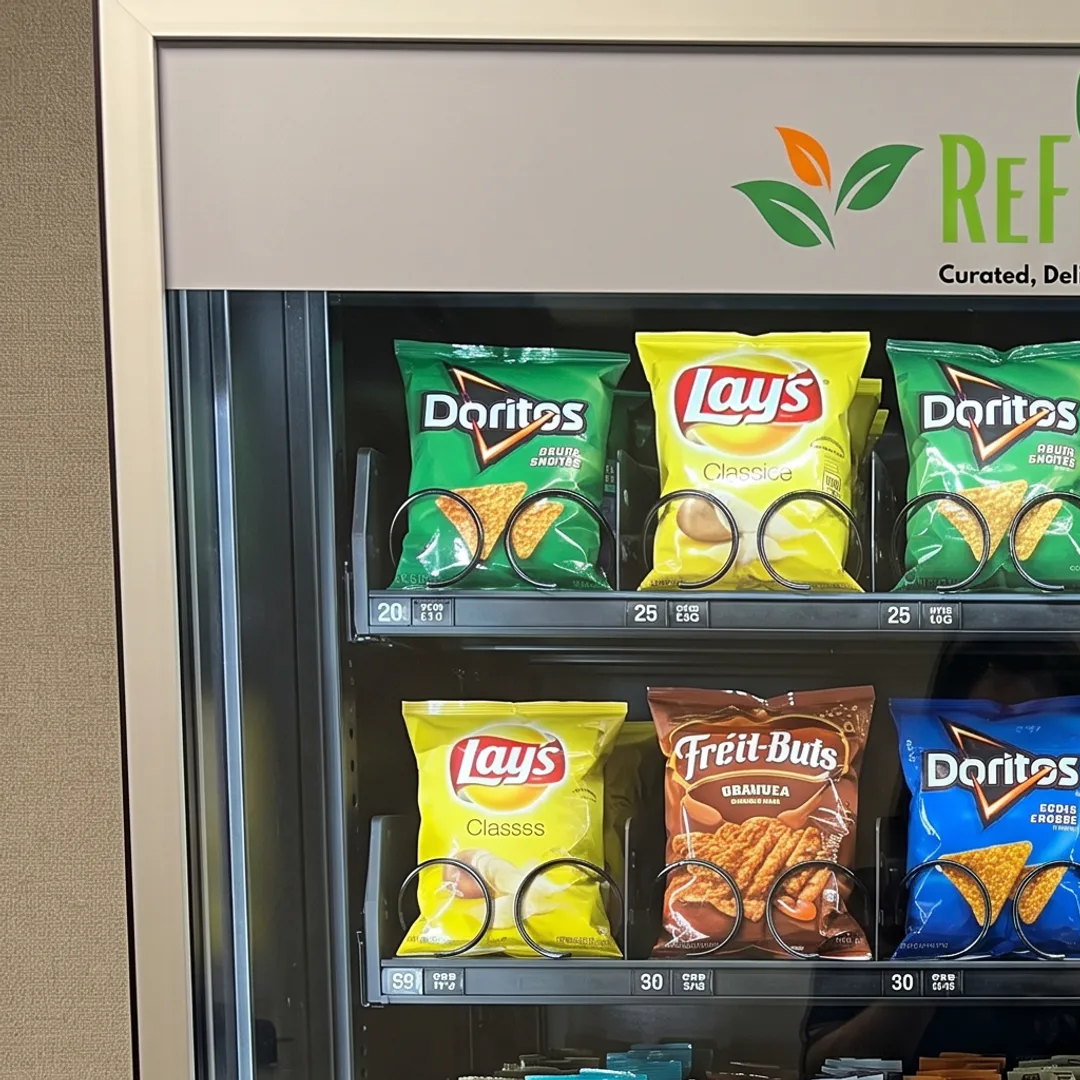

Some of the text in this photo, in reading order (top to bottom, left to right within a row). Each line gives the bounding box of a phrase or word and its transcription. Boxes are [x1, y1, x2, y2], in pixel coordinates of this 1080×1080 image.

[939, 264, 1038, 288] Curated,
[423, 394, 586, 432] Doritos
[924, 394, 1078, 431] Doritos
[377, 602, 401, 623] 20
[633, 604, 659, 623] 25
[887, 606, 912, 625] 25
[455, 736, 558, 787] Lay's
[927, 752, 1080, 788] Doritos
[640, 973, 663, 991] 30
[891, 973, 914, 991] 30
